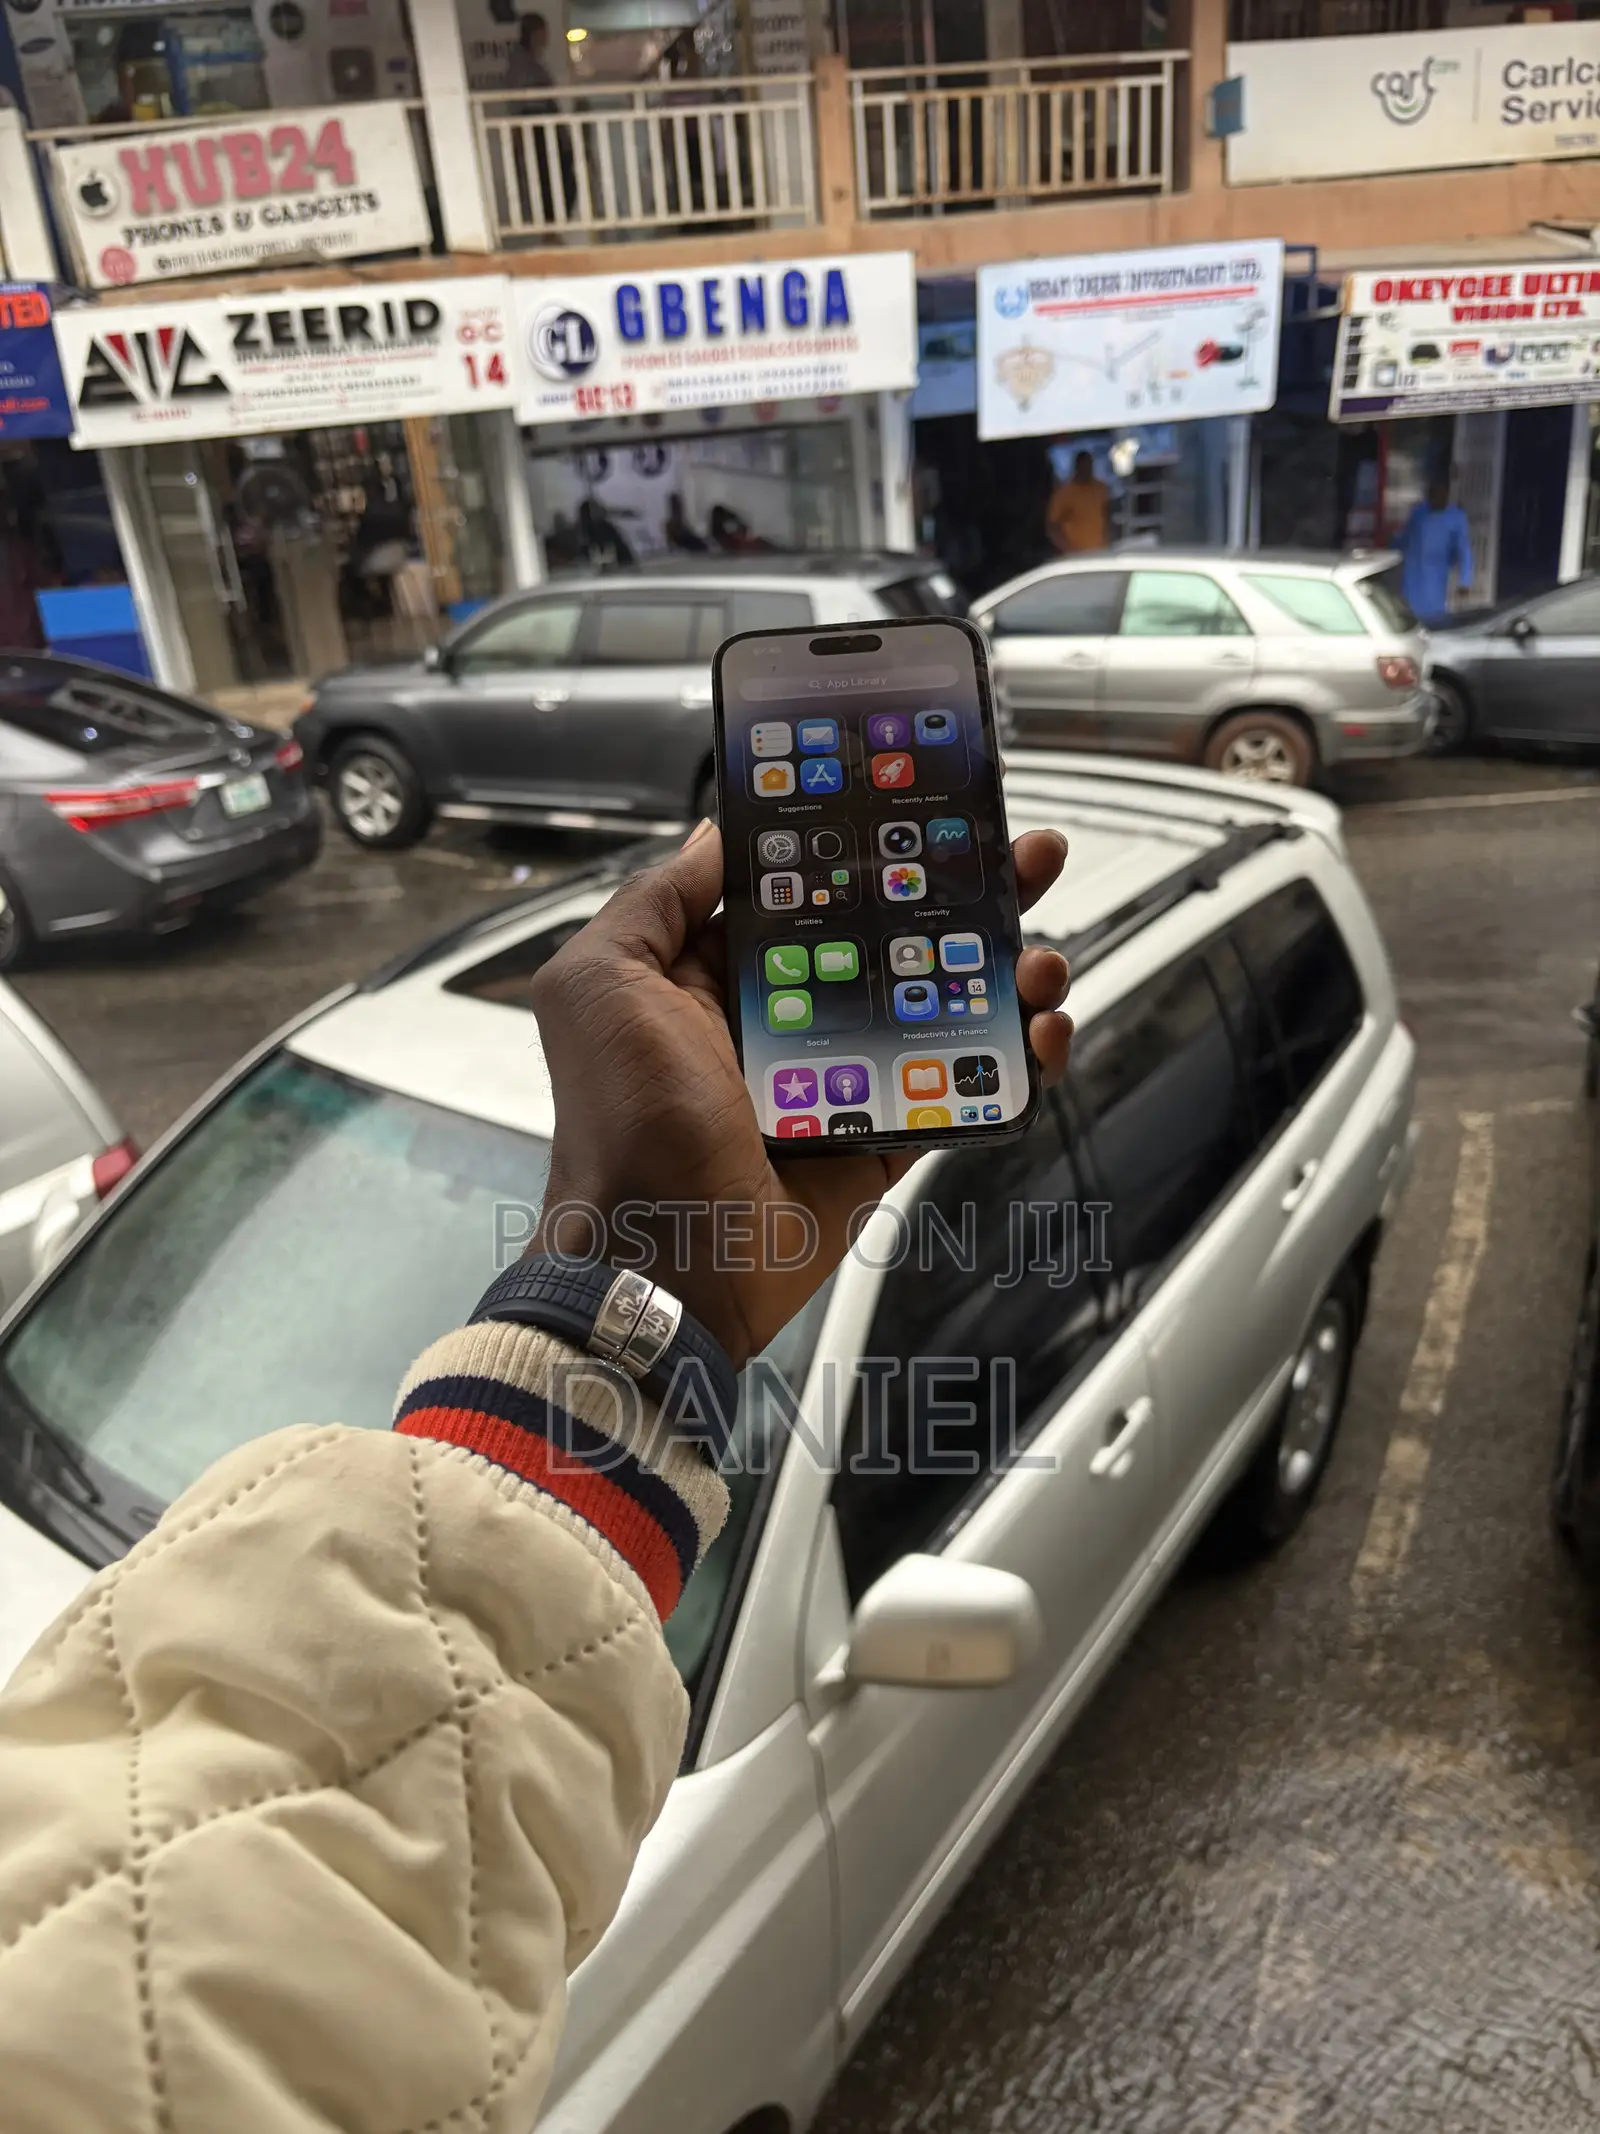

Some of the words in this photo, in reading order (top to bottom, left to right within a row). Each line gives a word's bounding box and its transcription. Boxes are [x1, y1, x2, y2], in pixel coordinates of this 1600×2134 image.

[1503, 57, 1600, 90] Carlc
[118, 117, 358, 217] HUB24
[615, 269, 851, 343] GBENGA
[226, 299, 442, 349] ZEERID
[463, 353, 508, 391] 14
[827, 679, 849, 689] App
[851, 676, 887, 688] Library
[924, 794, 948, 803] Added
[778, 804, 822, 813] Suggestions
[914, 908, 951, 918] Creativity
[794, 917, 823, 926] Utilities
[902, 1030, 948, 1041] Productivity
[958, 1027, 988, 1036] Finance
[806, 1039, 830, 1047] Social
